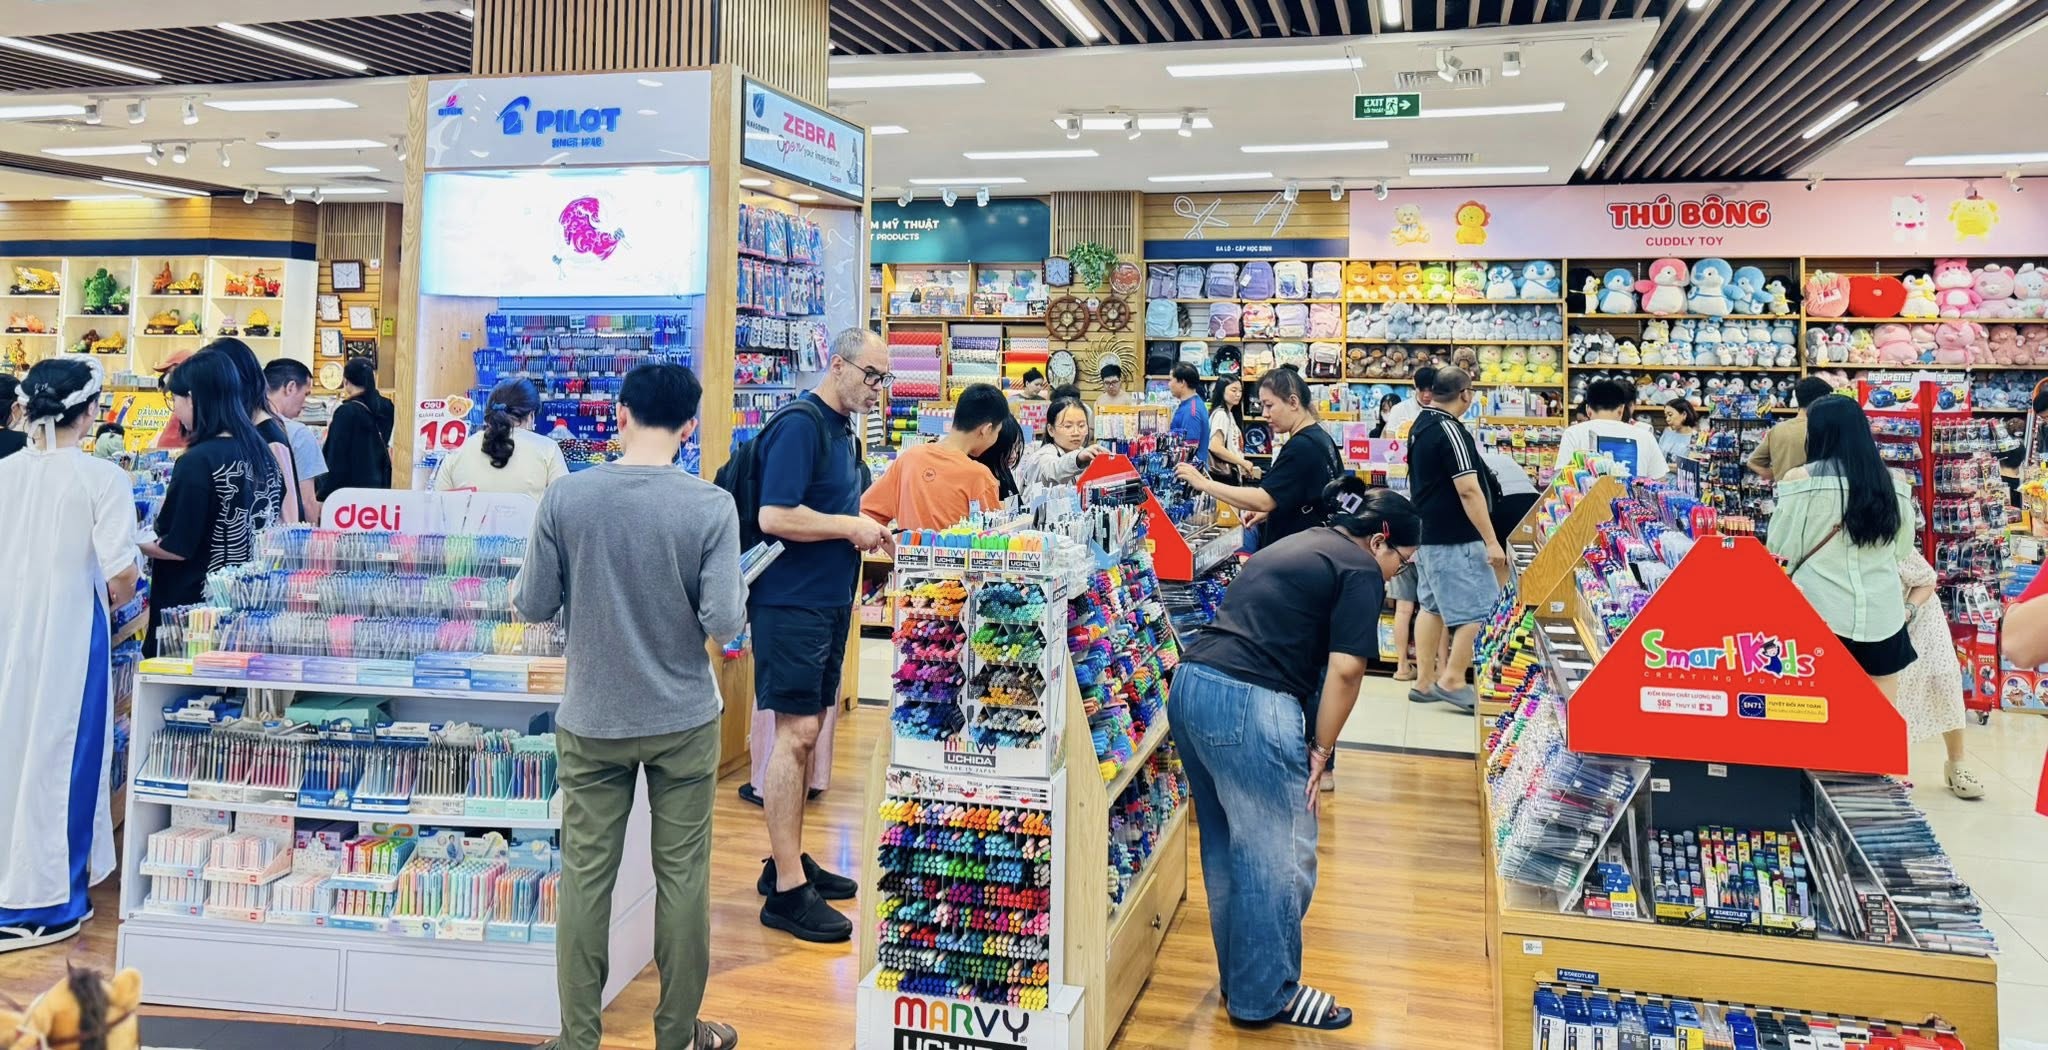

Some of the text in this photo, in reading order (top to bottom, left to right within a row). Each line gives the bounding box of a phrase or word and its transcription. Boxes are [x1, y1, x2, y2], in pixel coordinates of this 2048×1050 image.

[1364, 99, 1384, 107] EXIT
[536, 108, 620, 134] PILOT
[783, 112, 836, 151] ZEBRA
[1608, 194, 1771, 229] THÚ BÔNG
[882, 217, 899, 230] MỸ
[903, 217, 940, 231] THUẬT
[876, 233, 920, 241] PRODUCTS
[1646, 236, 1724, 247] CUDDLY TOY
[419, 420, 467, 450] 10
[1351, 446, 1368, 454] deli
[334, 503, 401, 531] deli
[1643, 671, 1815, 688] CREATING FUTURE
[1657, 698, 1671, 707] SGS
[1743, 701, 1762, 709] EN71
[947, 754, 993, 766] UCHIDA
[894, 996, 1029, 1042] MARVY
